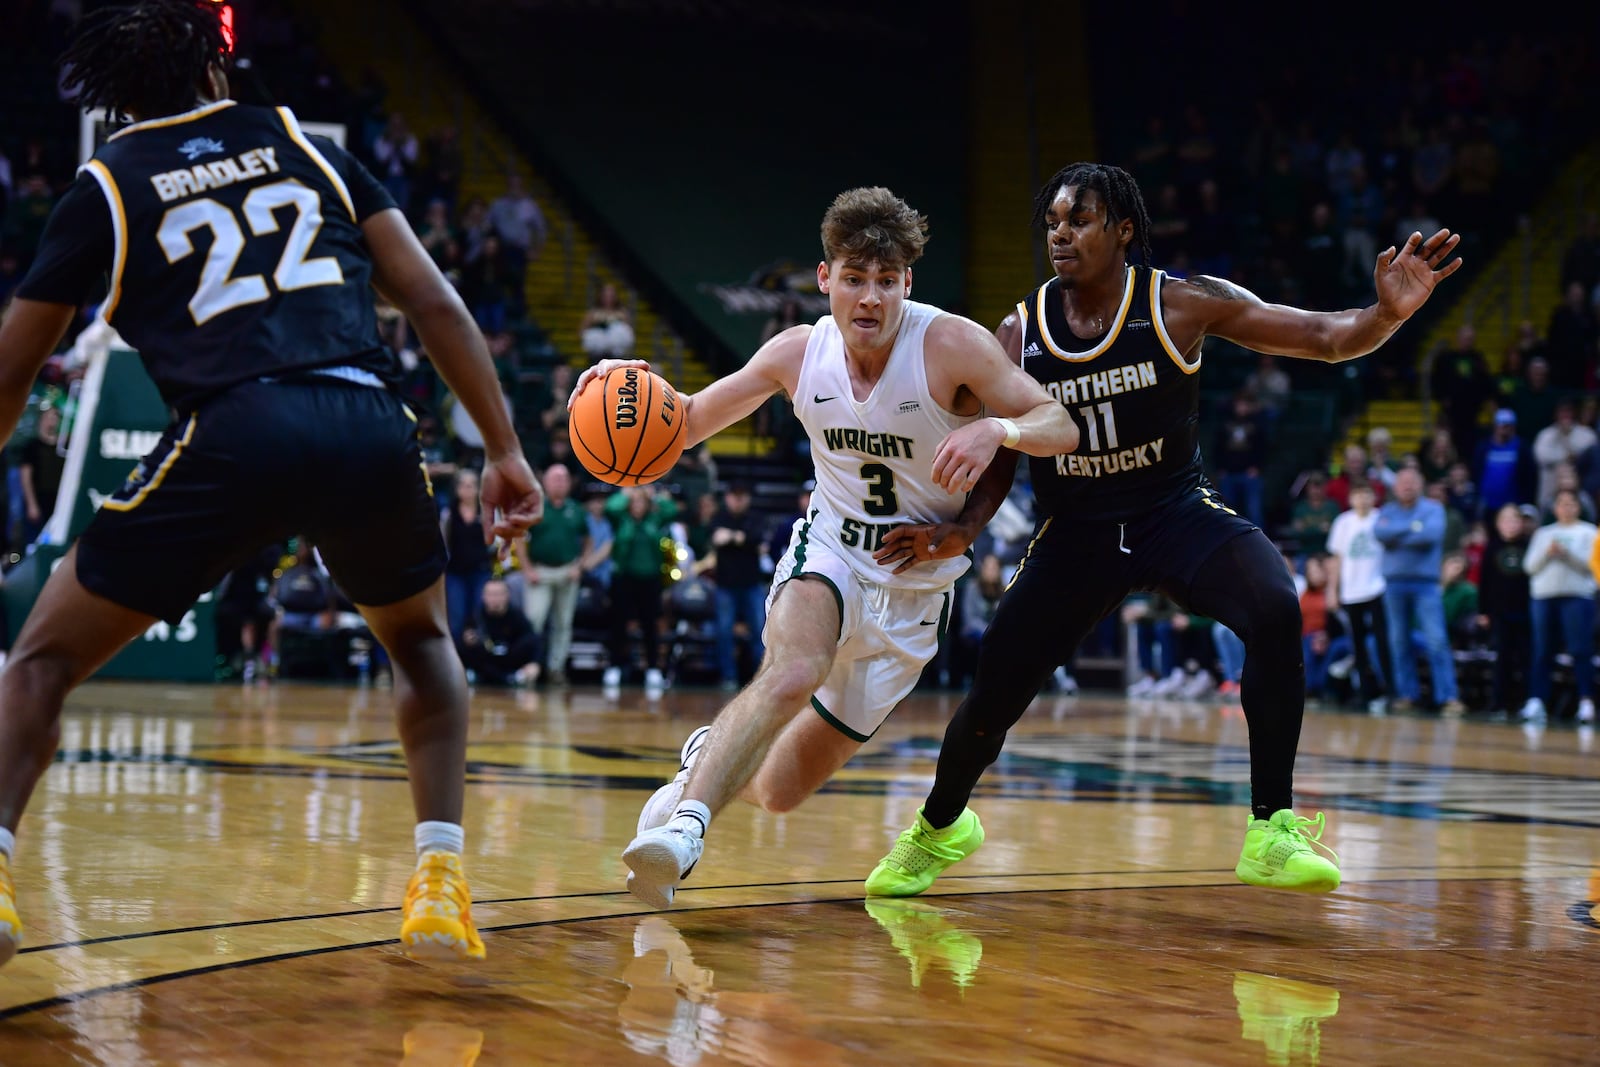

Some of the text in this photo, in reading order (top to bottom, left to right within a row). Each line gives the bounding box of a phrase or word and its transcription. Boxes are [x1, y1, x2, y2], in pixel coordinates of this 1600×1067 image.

[150, 146, 281, 202] BRADLEY
[155, 177, 345, 326] 22
[616, 368, 640, 430] Wilson
[1042, 360, 1158, 405] ORTHERN
[823, 428, 915, 460] WRIGHT
[1079, 401, 1119, 452] 11
[1055, 438, 1165, 478] KENTUCKY
[860, 461, 899, 517] 3
[840, 517, 905, 552] STA
